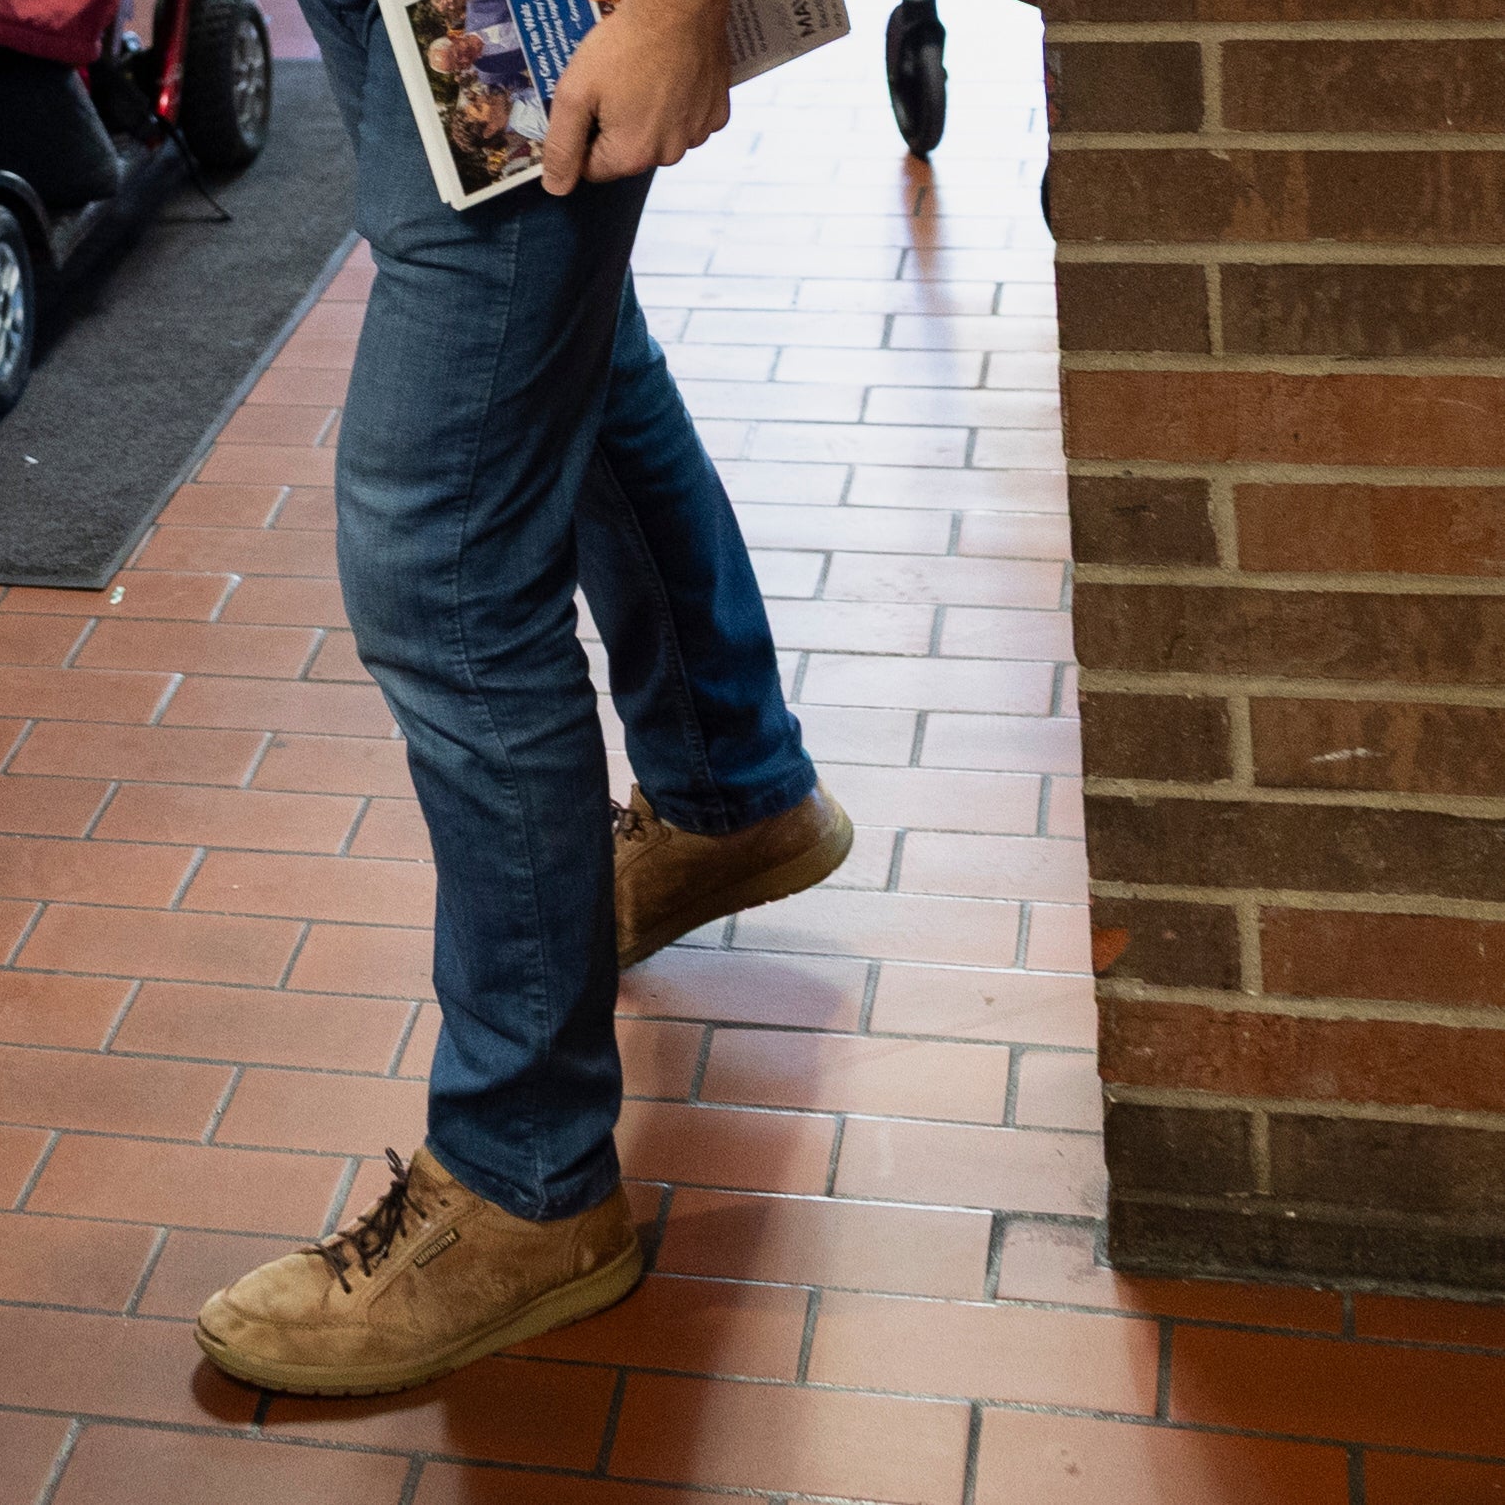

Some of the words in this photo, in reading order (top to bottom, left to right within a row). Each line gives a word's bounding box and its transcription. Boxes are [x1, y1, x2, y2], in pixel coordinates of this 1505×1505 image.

[520, 2, 537, 30] Walz
[529, 29, 543, 53] Tim
[537, 53, 550, 77] Gov.
